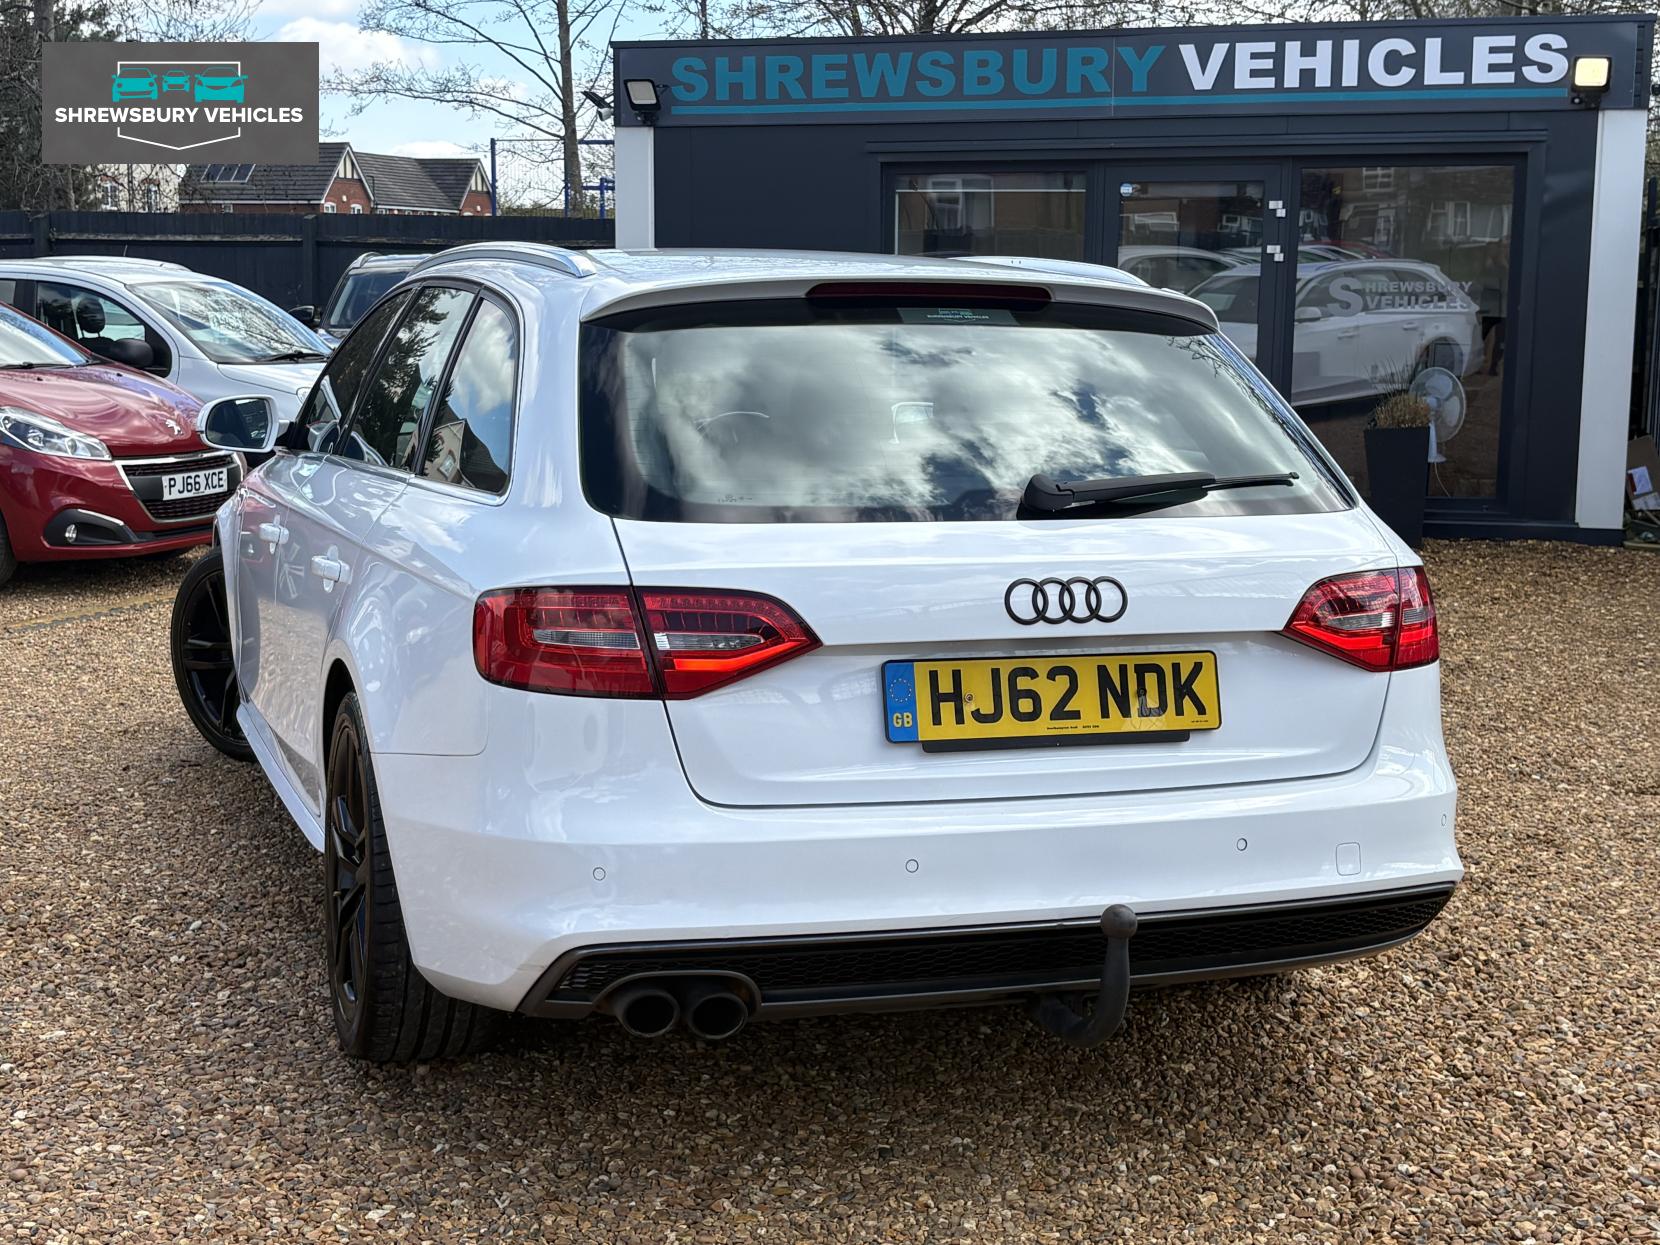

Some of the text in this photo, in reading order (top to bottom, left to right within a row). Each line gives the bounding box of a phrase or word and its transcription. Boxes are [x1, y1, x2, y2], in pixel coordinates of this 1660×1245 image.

[671, 33, 1569, 101] SHREWSBURY VEHICLES
[168, 470, 224, 496] PJ66 XCE
[929, 661, 1207, 727] HJ62 NDK
[892, 711, 913, 728] GB
